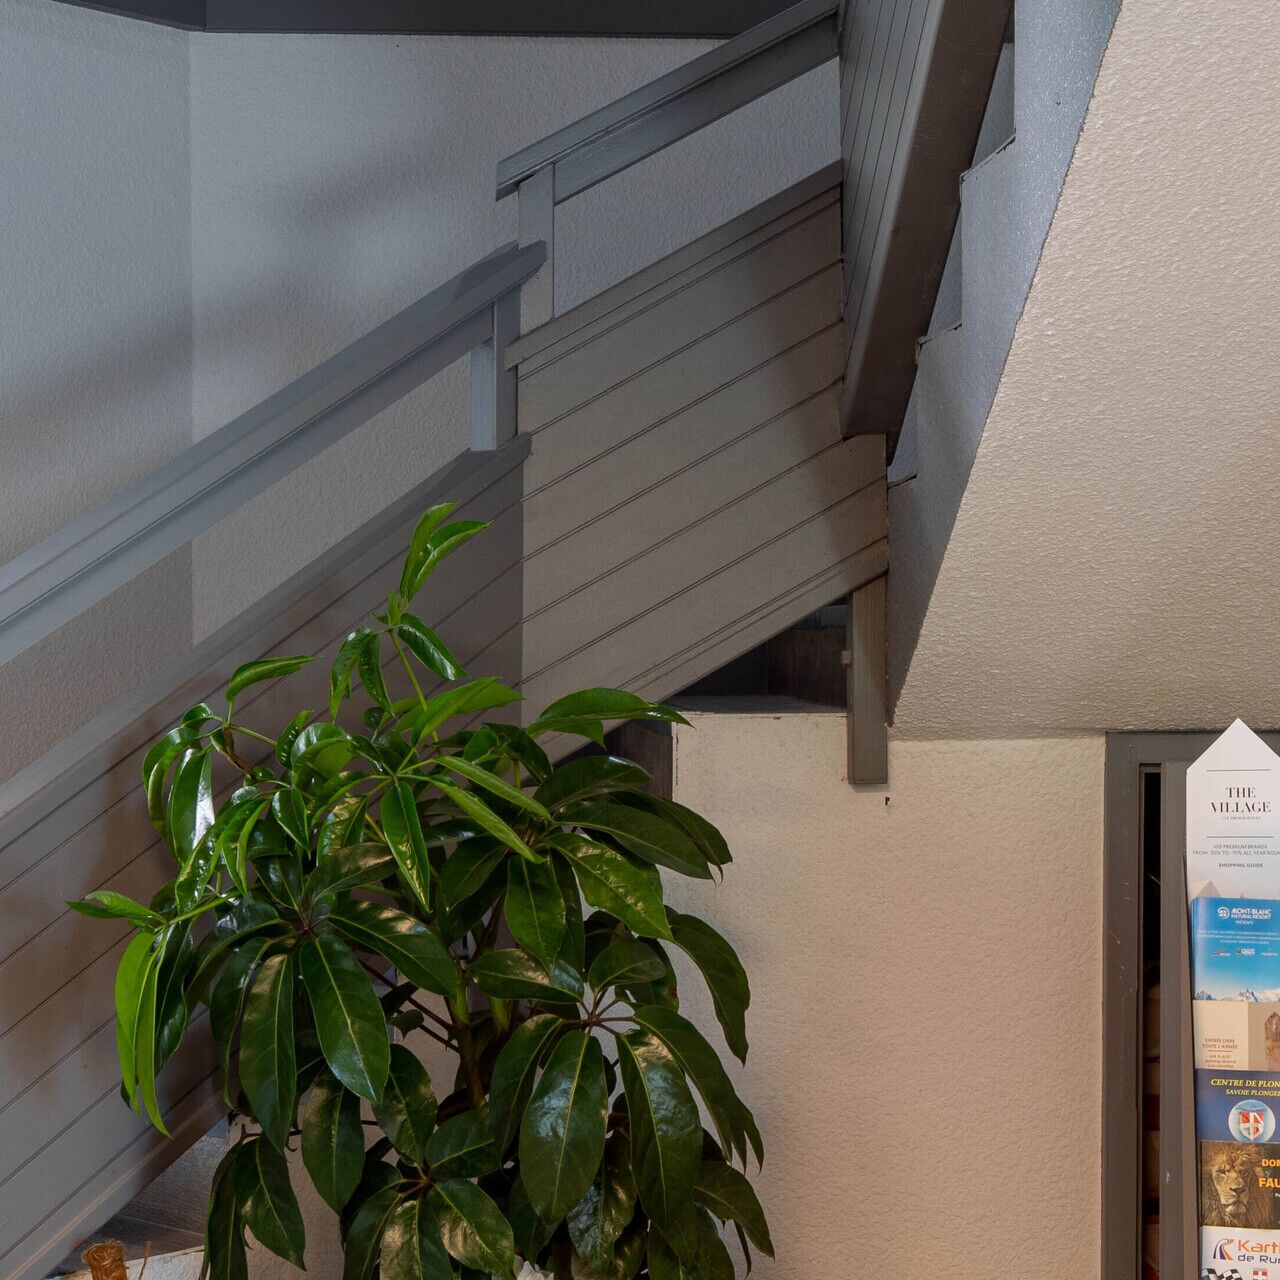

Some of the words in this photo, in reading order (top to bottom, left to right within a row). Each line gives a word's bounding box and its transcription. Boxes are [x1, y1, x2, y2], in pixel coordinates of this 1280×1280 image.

[1226, 787, 1256, 798] THE
[1211, 802, 1271, 813] VILLAGE
[1238, 1253, 1255, 1262] de
